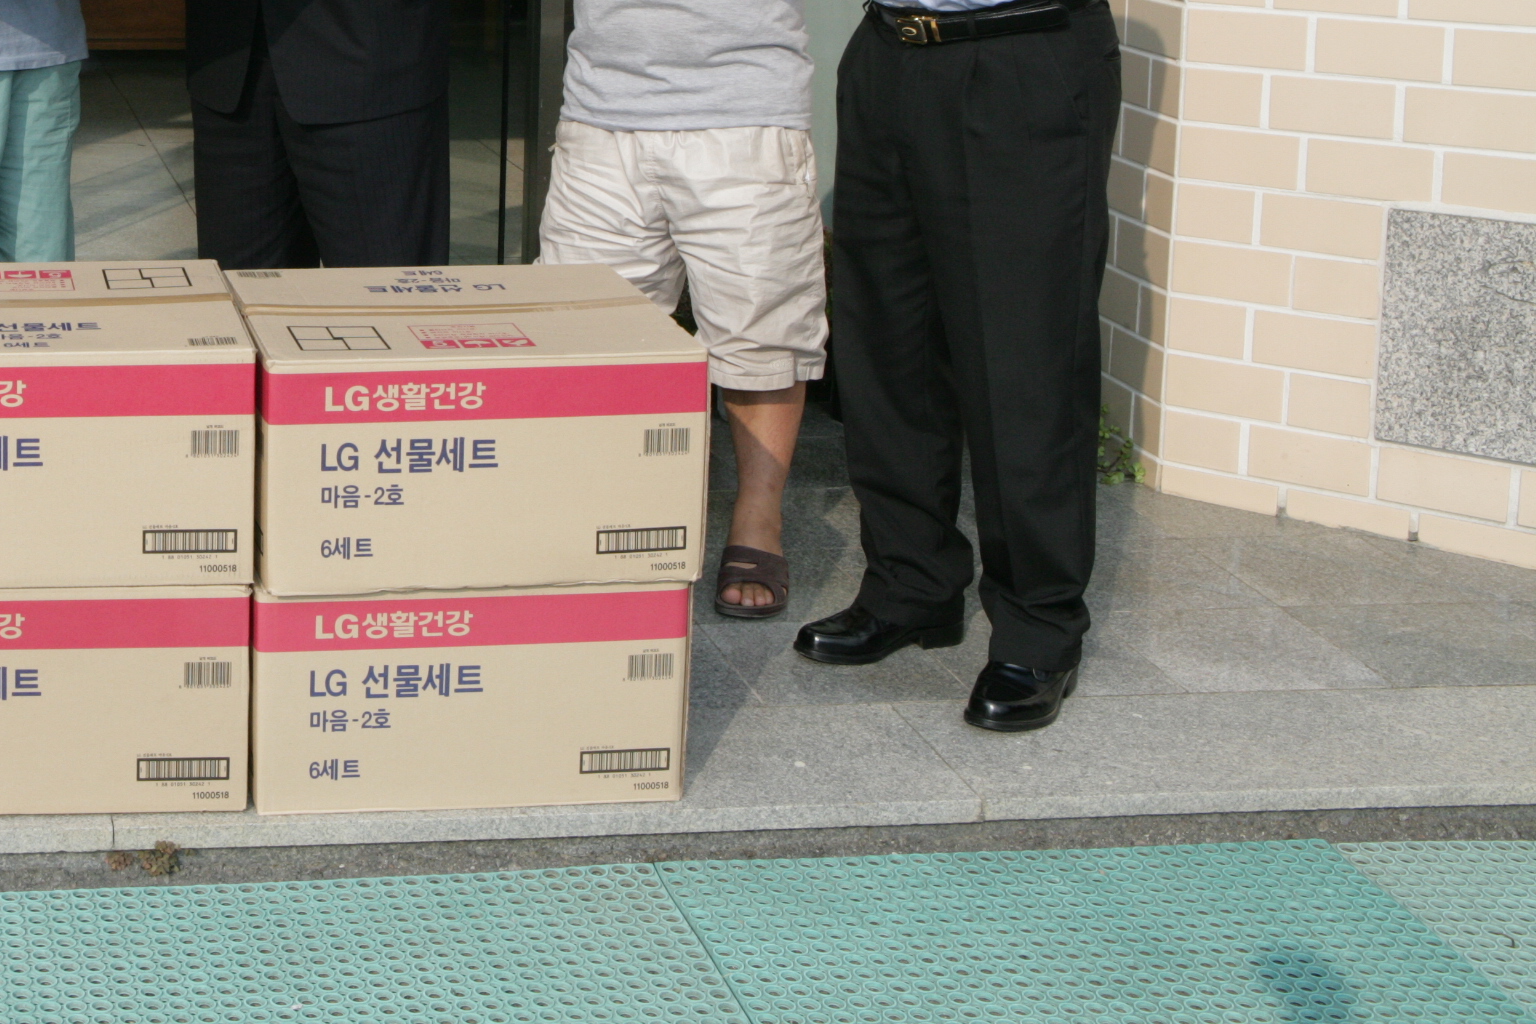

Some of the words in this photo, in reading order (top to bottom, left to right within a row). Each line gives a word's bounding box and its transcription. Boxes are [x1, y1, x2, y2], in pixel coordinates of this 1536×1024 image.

[363, 284, 462, 293] 선물세트
[472, 283, 506, 292] LG
[325, 382, 486, 412] LG생활건강
[321, 442, 359, 471] LG
[374, 436, 498, 473] 선물세트
[321, 484, 404, 508] 마음-2호
[320, 537, 373, 560] 6세트
[199, 564, 237, 572] 11000518
[650, 561, 686, 570] 11000518
[315, 610, 473, 639] LG생활건강
[310, 669, 347, 697] LG
[362, 663, 483, 698] 선물세트
[310, 708, 391, 732] 마음-2호
[309, 759, 360, 780] 6세트
[192, 791, 229, 799] 11000518
[633, 781, 669, 790] 11000518
